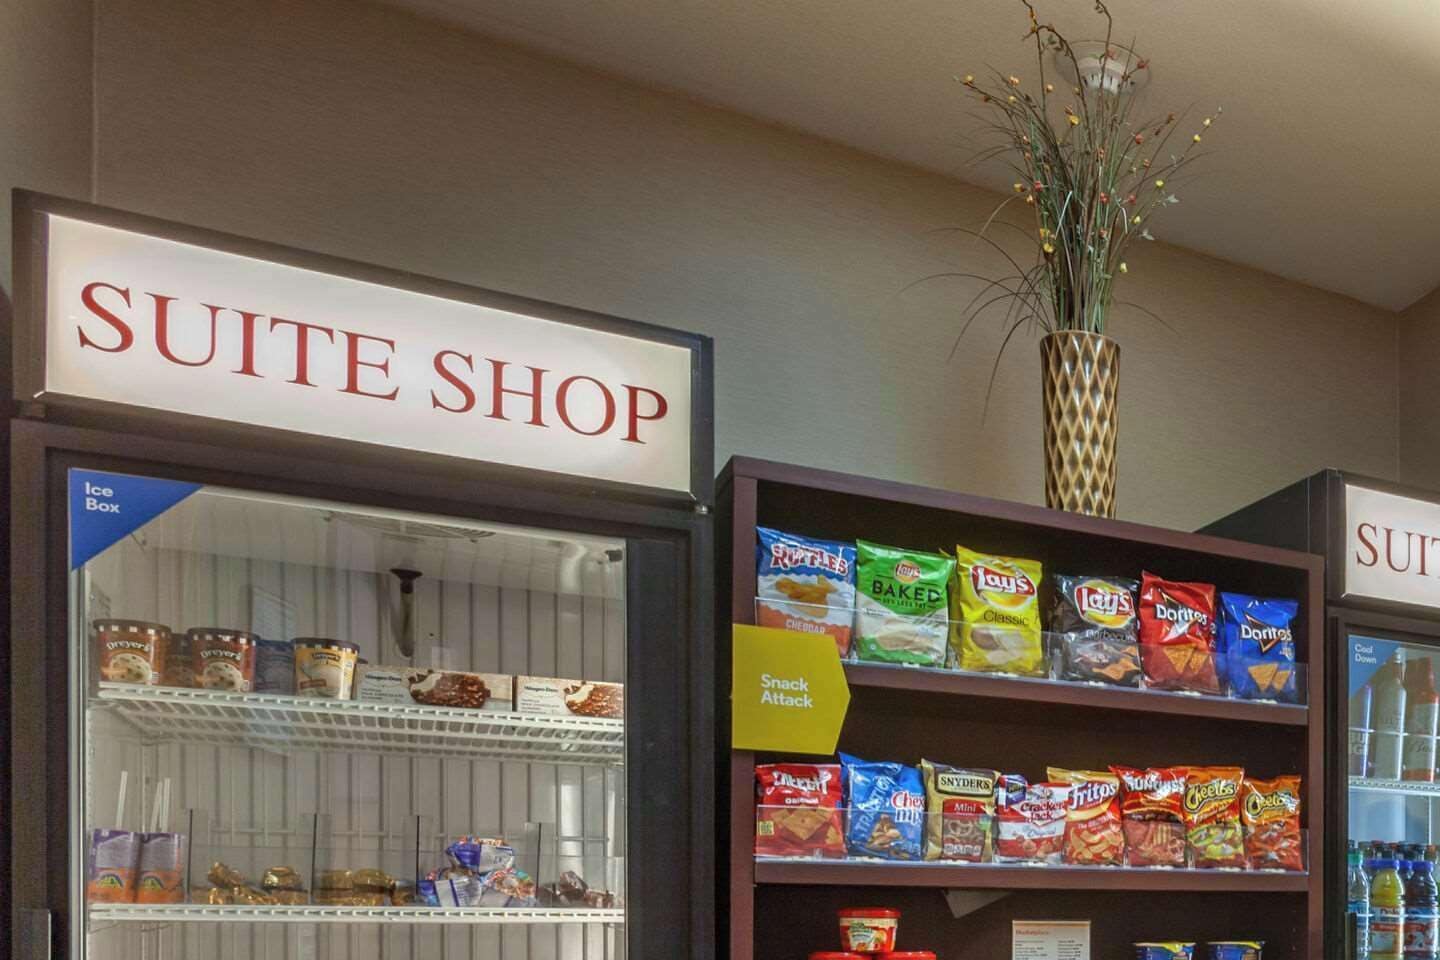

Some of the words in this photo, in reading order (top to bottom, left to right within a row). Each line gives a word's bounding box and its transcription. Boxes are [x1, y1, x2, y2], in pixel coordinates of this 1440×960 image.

[77, 281, 400, 401] SUITE
[430, 349, 668, 444] SHOP
[84, 481, 114, 498] Ice
[84, 497, 121, 514] Box
[770, 543, 849, 576] RUFFLES
[976, 566, 1033, 595] Lay's
[872, 579, 941, 603] BAKED
[1081, 587, 1132, 616] Lay's
[983, 609, 1030, 626] Classic
[1155, 603, 1208, 626] Doritos
[1241, 624, 1293, 642] Doritos
[1354, 643, 1374, 654] Cool
[1354, 653, 1377, 665] Down
[760, 674, 809, 692] Snack
[760, 690, 814, 709] Attack
[890, 790, 926, 809] Chex
[1068, 780, 1117, 810] Fritos
[1185, 778, 1236, 812] Cheetos
[954, 802, 976, 813] Mini
